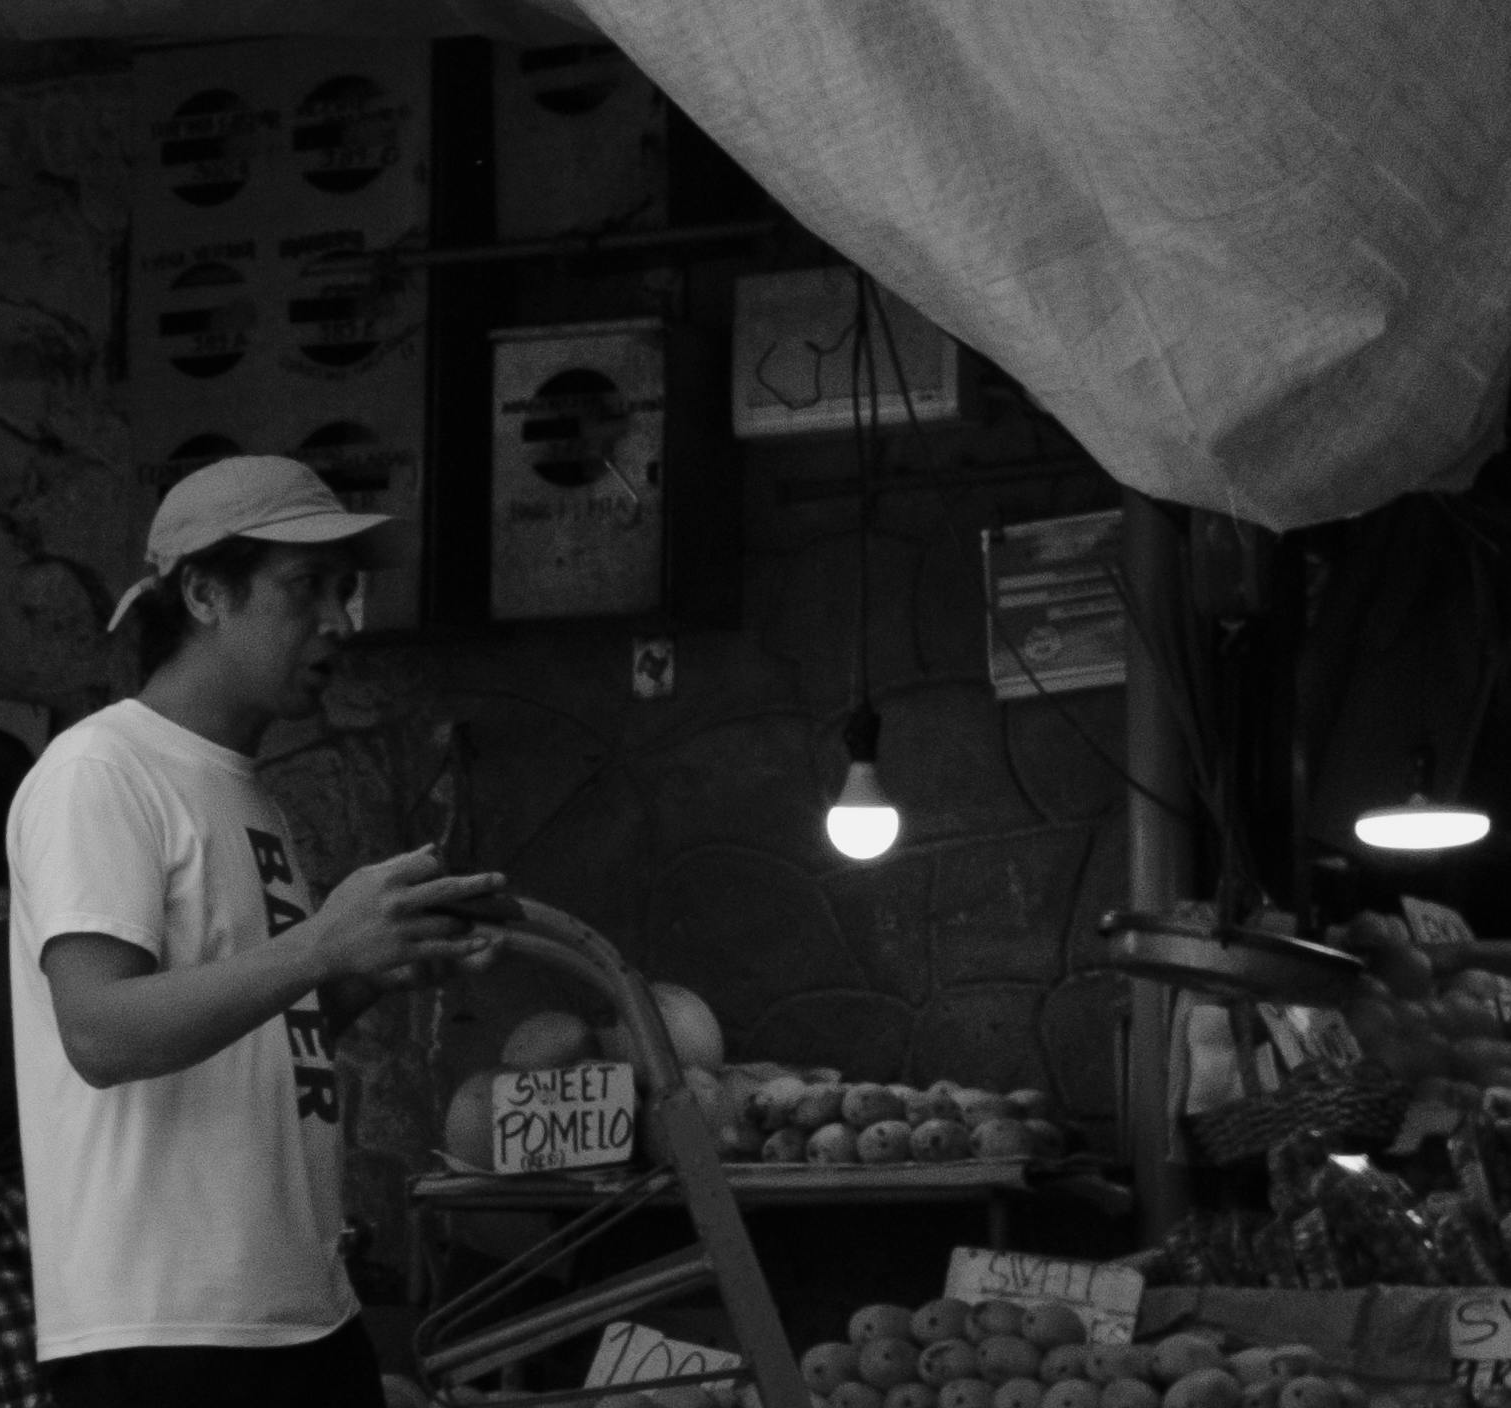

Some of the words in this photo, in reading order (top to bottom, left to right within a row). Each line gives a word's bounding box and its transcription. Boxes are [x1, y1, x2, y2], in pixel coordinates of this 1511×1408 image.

[244, 826, 340, 1126] BAER
[508, 1065, 615, 1106] SWEET
[497, 1107, 635, 1164] POMELO
